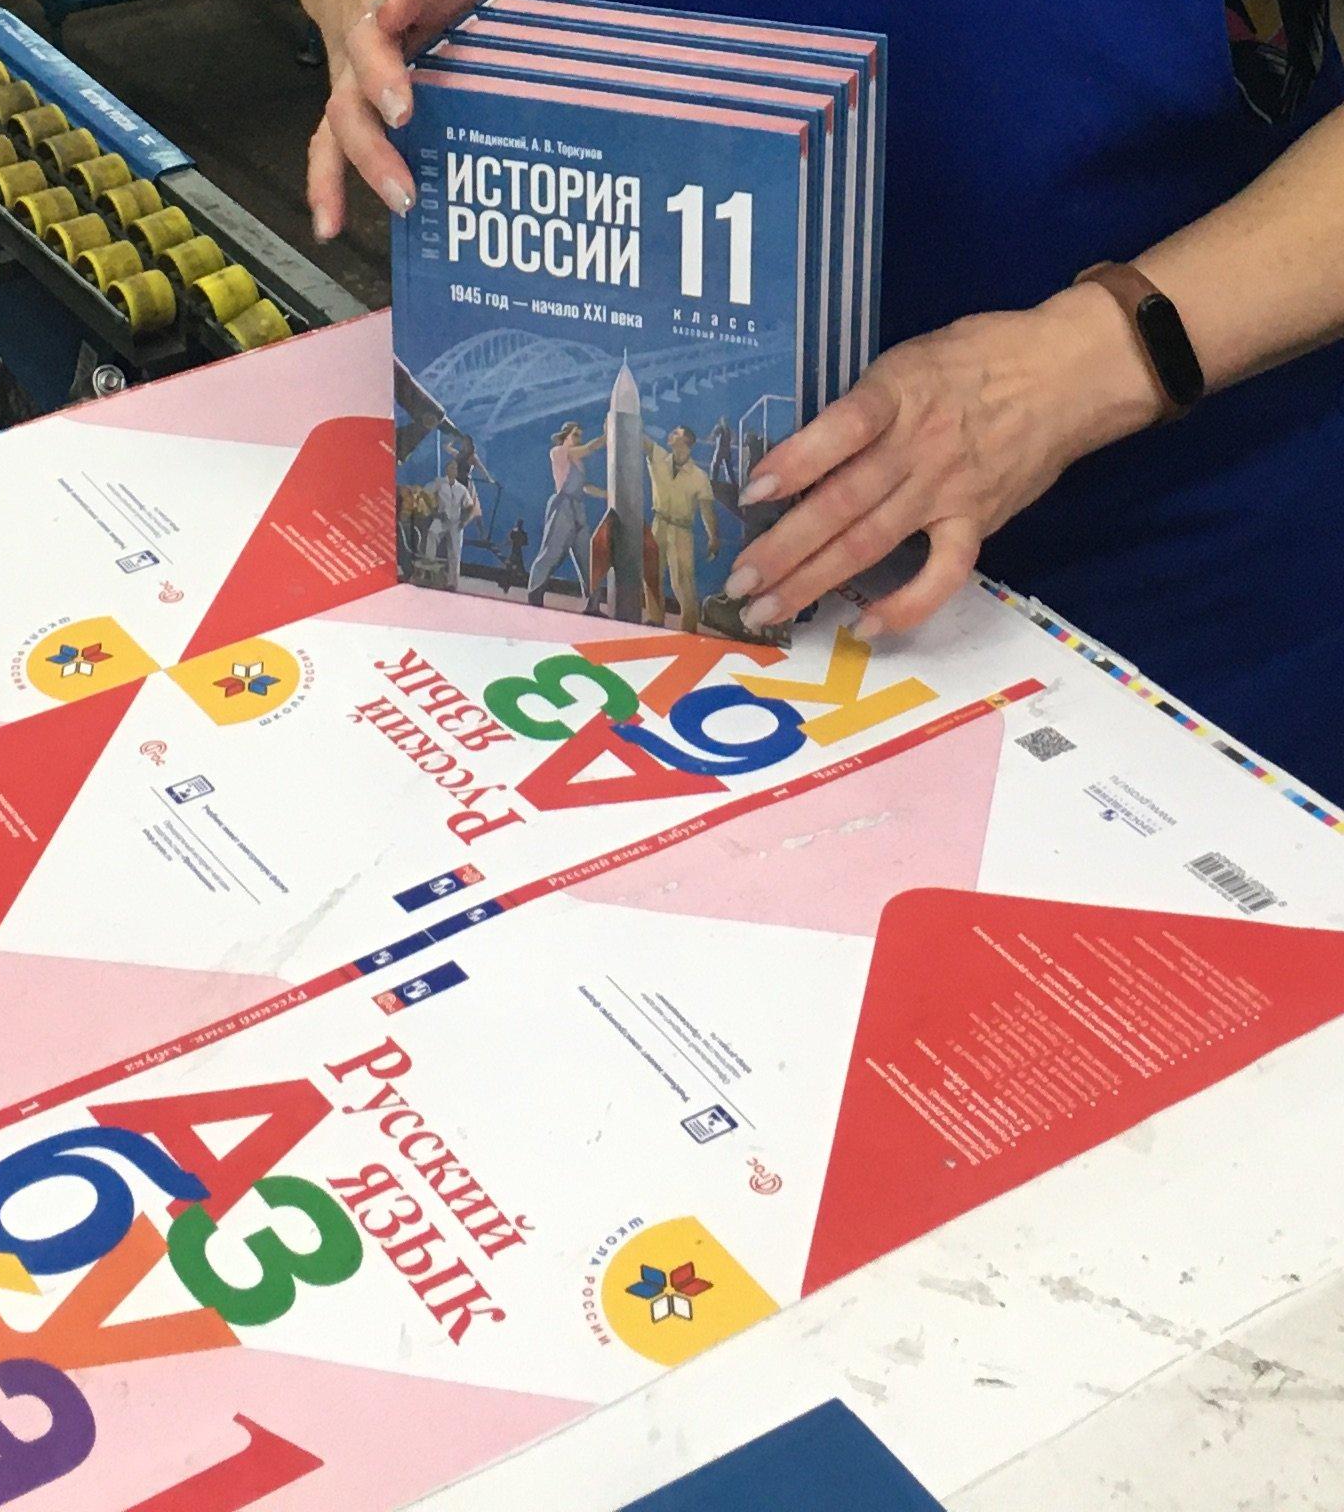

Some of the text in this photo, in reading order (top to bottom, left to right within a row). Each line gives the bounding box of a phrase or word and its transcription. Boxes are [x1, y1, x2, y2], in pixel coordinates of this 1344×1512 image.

[447, 127, 456, 140] В.
[470, 130, 528, 151] Мединский,
[531, 140, 541, 152] А.
[544, 140, 554, 153] В.
[557, 141, 603, 160] Торкунов
[447, 152, 640, 228] ИСТОРИЯ
[421, 148, 439, 260] ИСТОРИЯ
[448, 204, 640, 288] РОССИИ
[667, 184, 753, 305] 11
[450, 284, 481, 304] 1945
[485, 294, 509, 311] год
[531, 299, 579, 319] начало
[611, 311, 643, 328] века
[374, 648, 516, 752] язык
[348, 695, 526, 846] Русский
[546, 852, 610, 891] Русский
[237, 986, 308, 1028] Русский
[324, 1036, 533, 1261] Русский
[327, 1162, 506, 1346] язык
[582, 1216, 644, 1346] ШКОЛА РОССИИ
